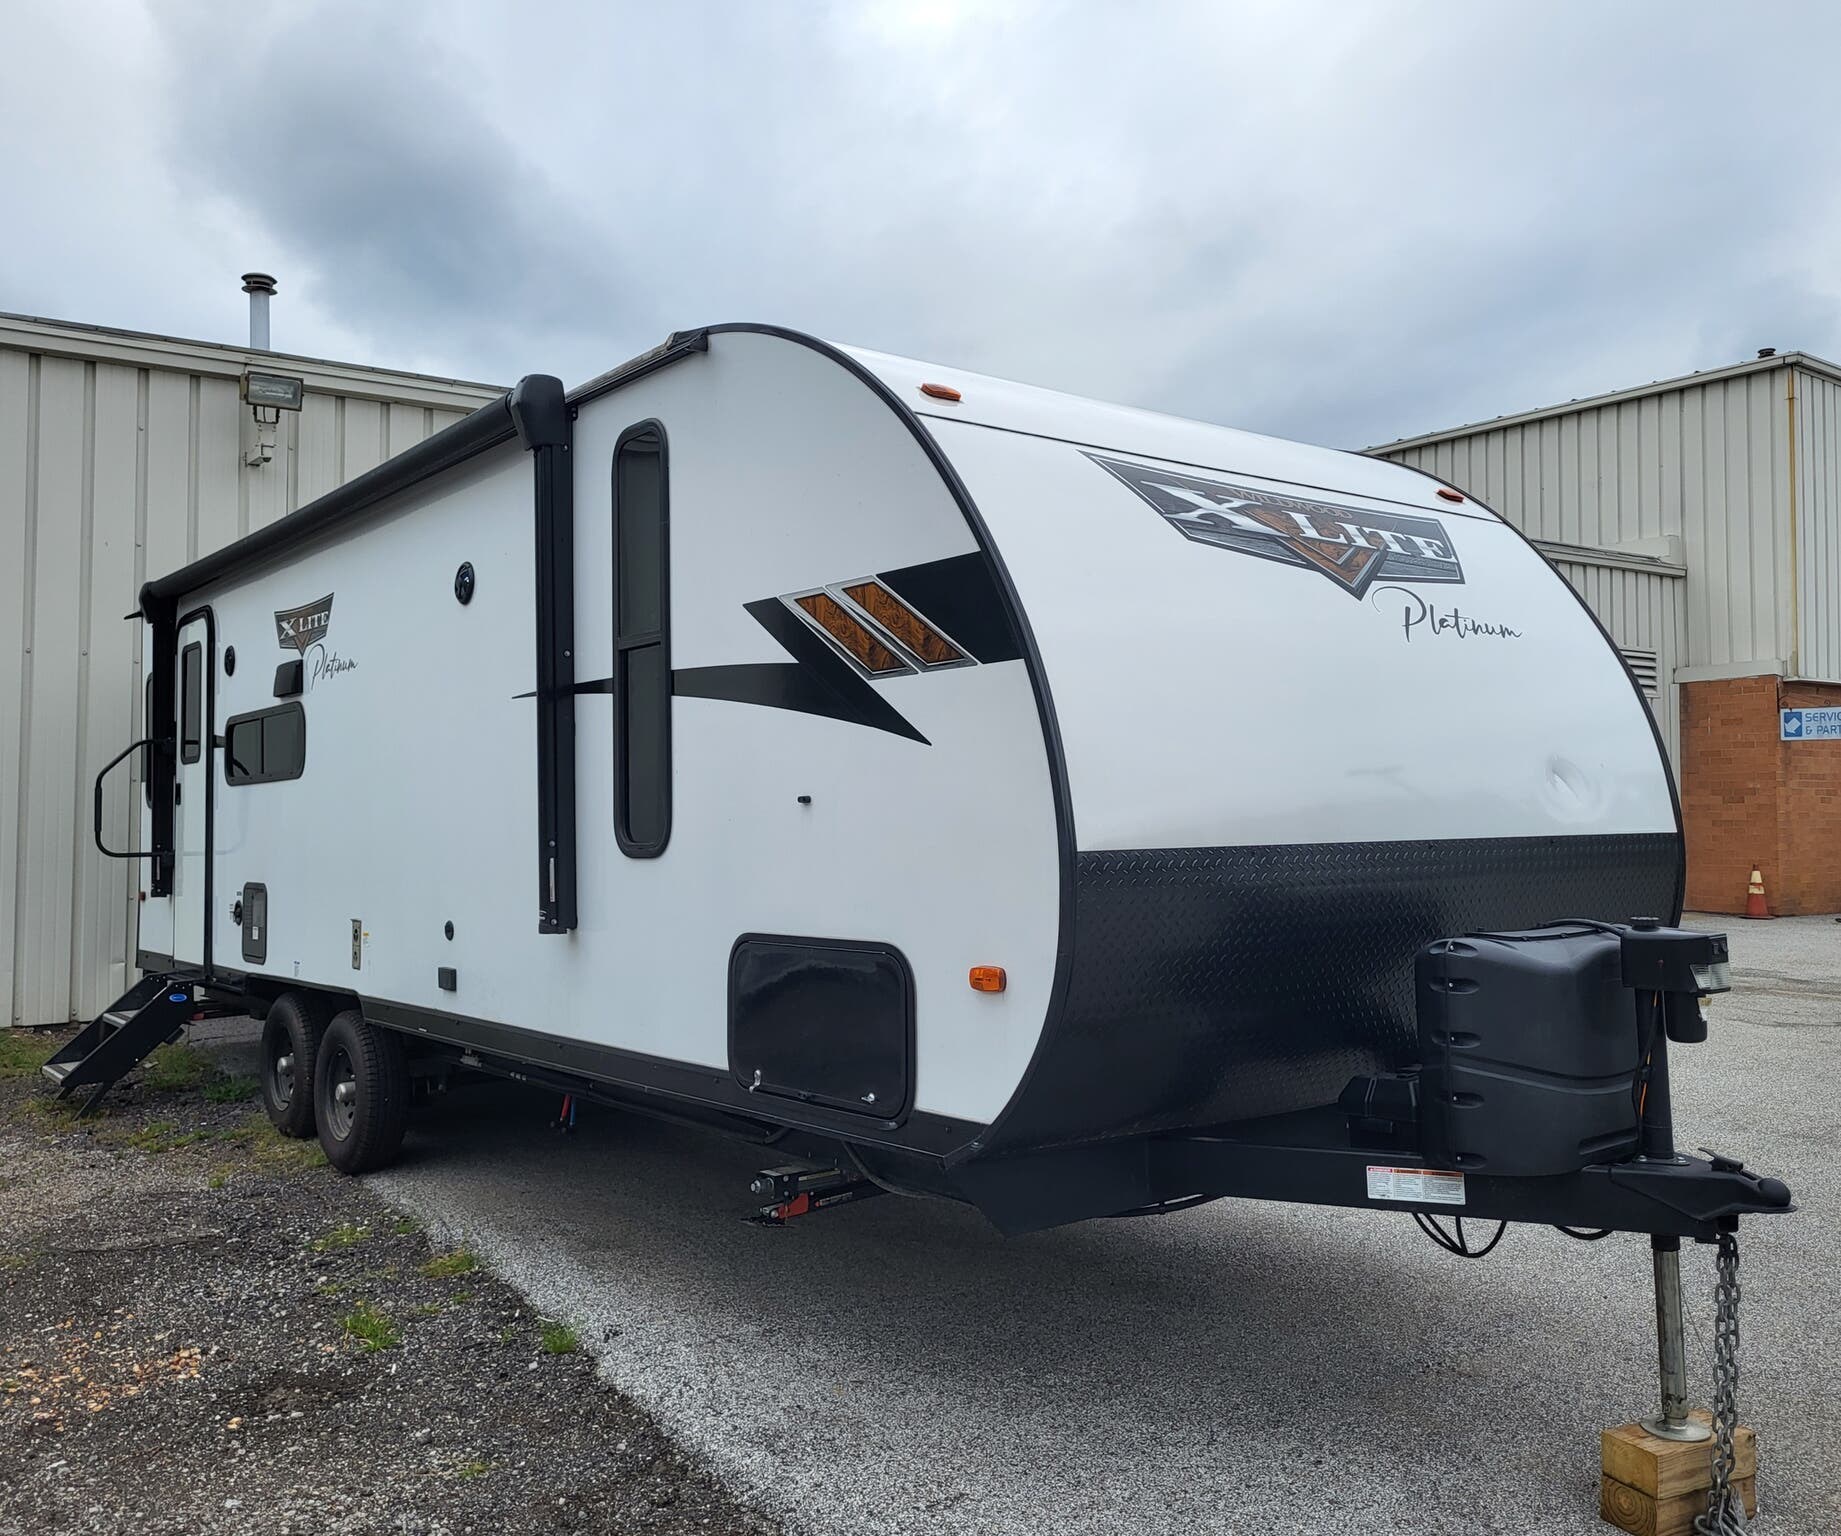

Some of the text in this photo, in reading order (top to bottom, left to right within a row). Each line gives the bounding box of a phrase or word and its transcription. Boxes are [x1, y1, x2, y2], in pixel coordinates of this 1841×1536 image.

[1140, 480, 1459, 564] X LITE
[279, 611, 329, 640] X LITE
[1371, 585, 1523, 643] Platinum
[306, 643, 358, 691] Platinum
[1805, 725, 1813, 735] &
